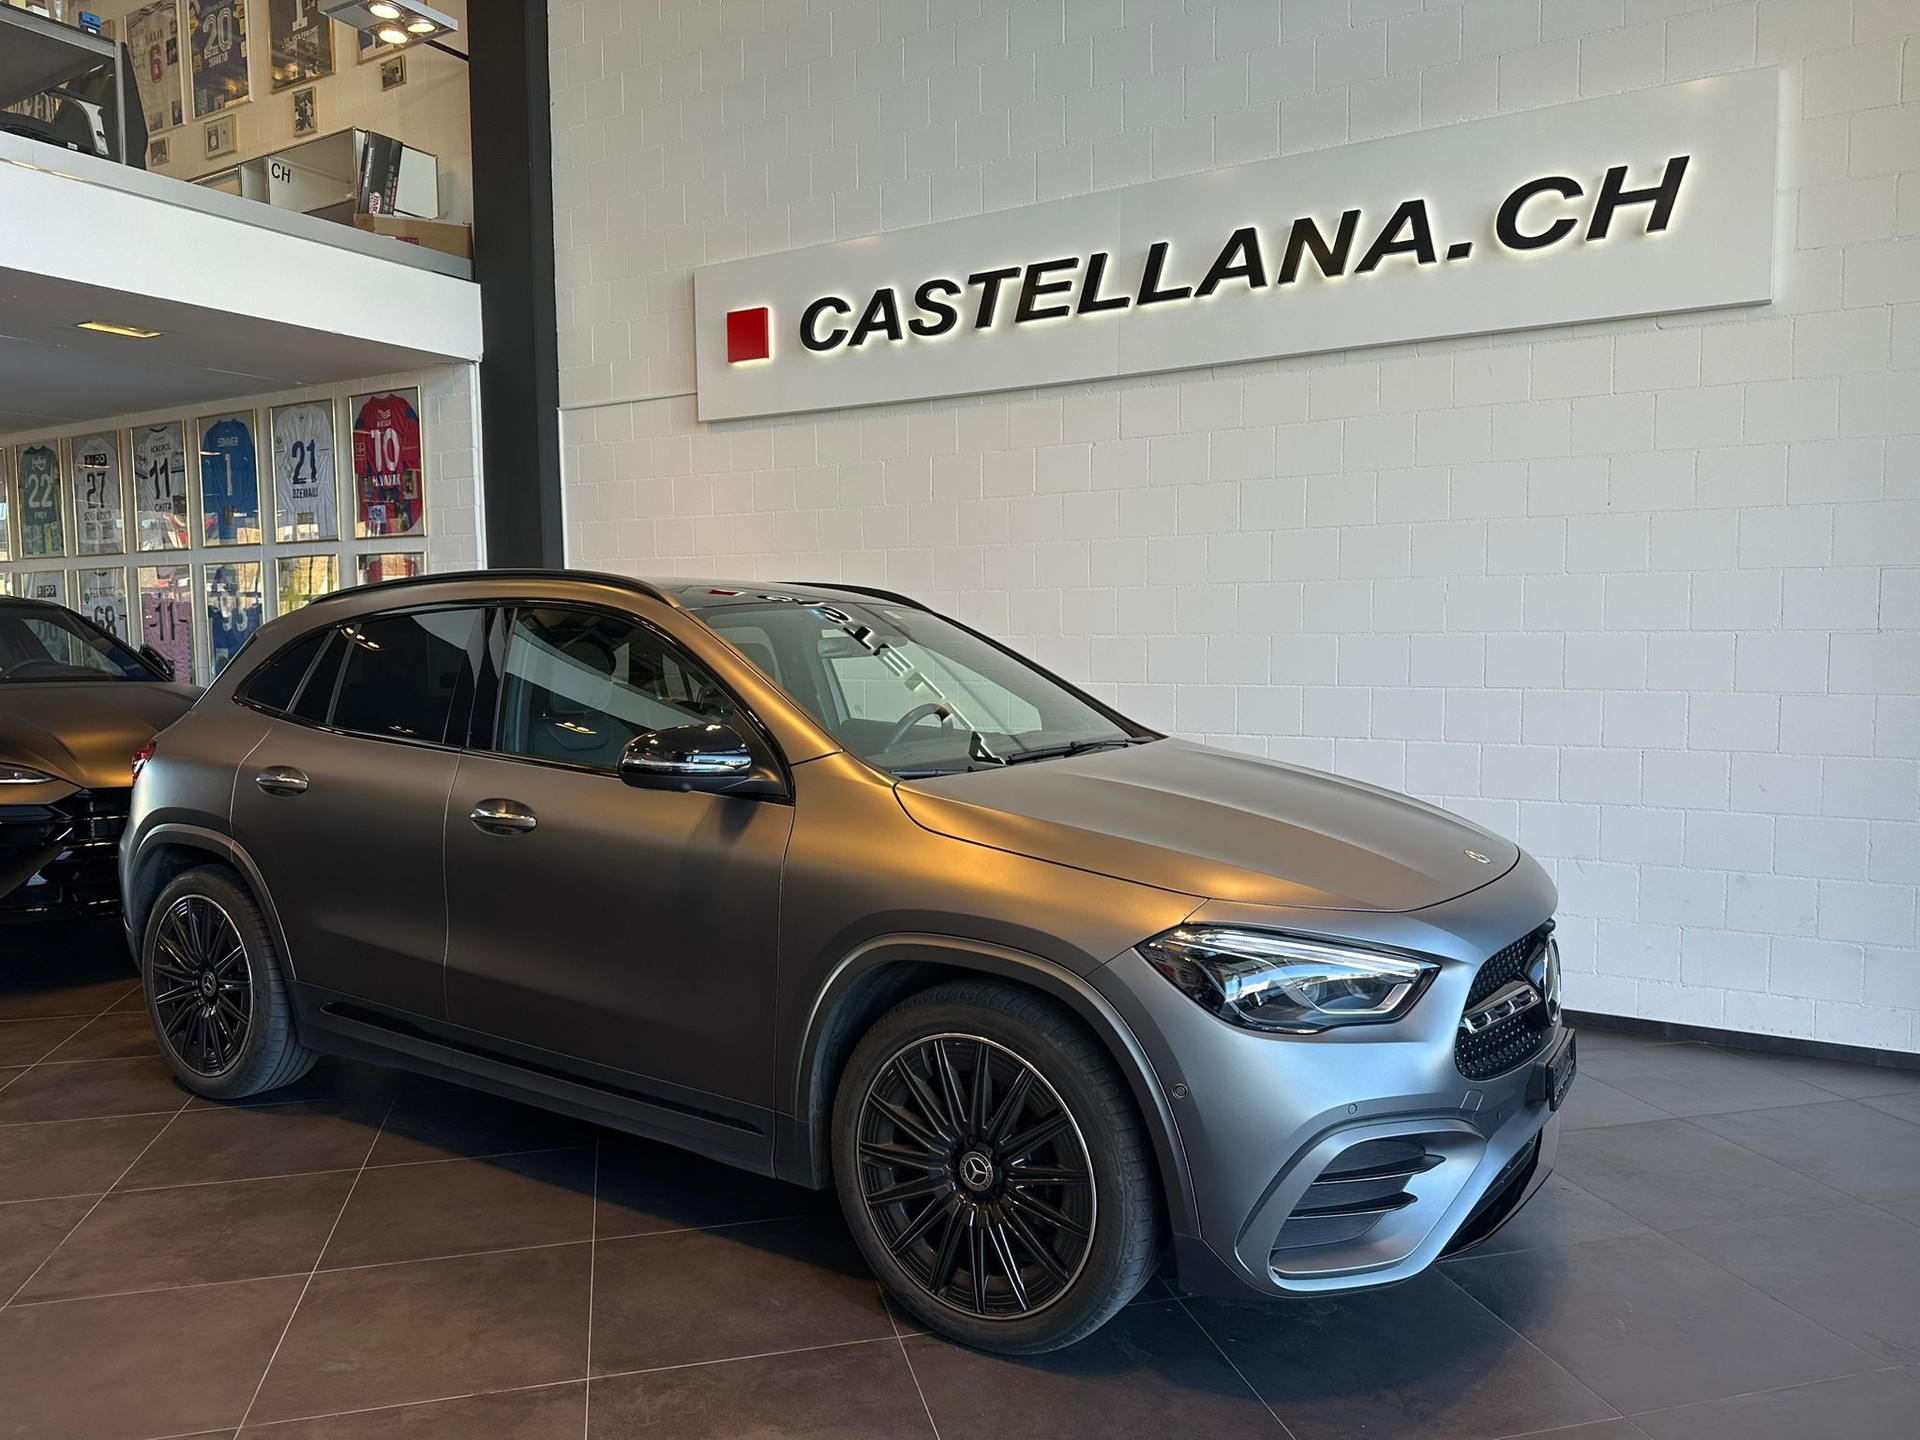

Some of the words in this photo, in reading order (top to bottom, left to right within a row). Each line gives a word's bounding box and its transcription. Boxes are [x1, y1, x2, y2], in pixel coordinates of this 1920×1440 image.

[203, 7, 233, 60] 20
[271, 162, 291, 184] CH
[799, 155, 1691, 351] CASTELLANA.CH
[217, 436, 239, 448] SOMMER
[291, 438, 317, 485] 21
[370, 427, 400, 472] 10
[28, 473, 53, 508] 22
[86, 471, 106, 509] 27
[149, 458, 171, 500] 11
[224, 453, 233, 496] 1
[155, 601, 176, 641] 11
